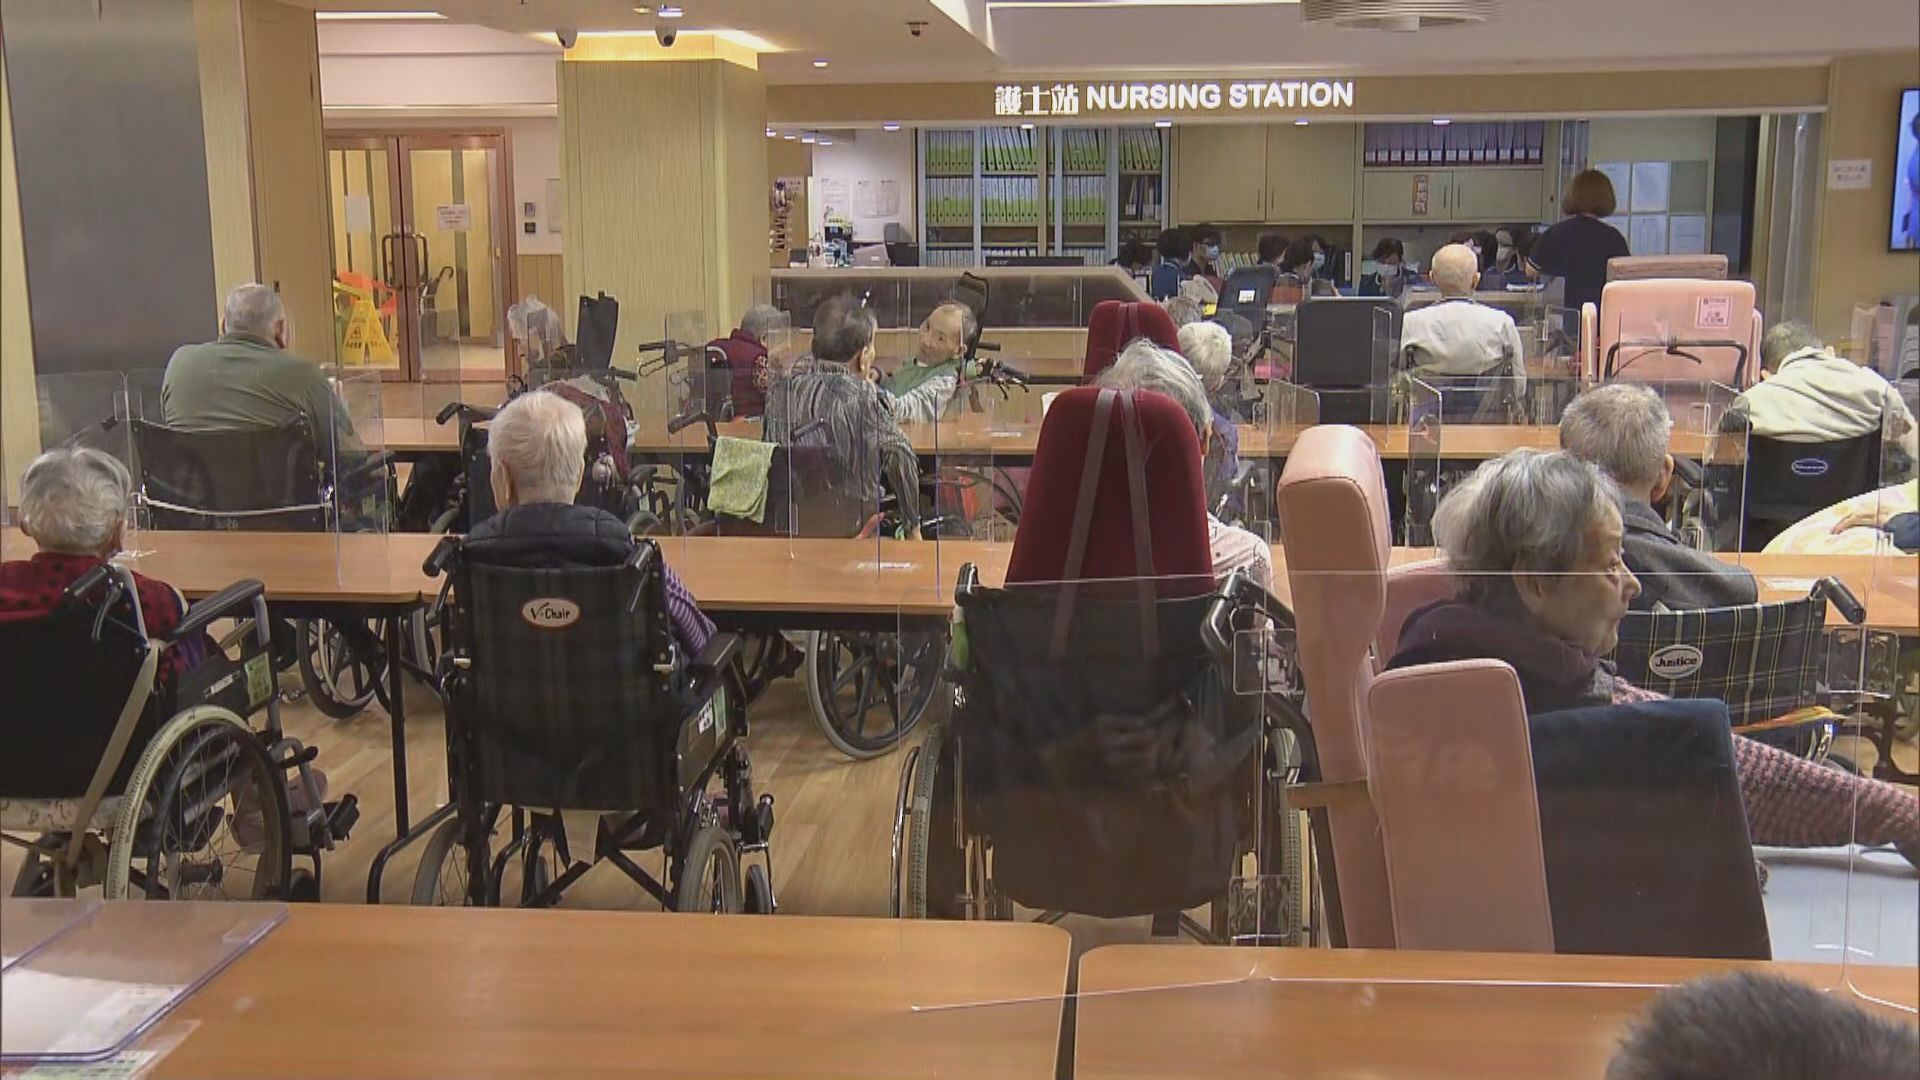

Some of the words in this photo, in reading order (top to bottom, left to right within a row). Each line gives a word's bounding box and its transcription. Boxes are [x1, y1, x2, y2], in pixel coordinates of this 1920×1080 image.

[995, 84, 1079, 115] 護士站
[1086, 83, 1221, 110] NURSING
[1229, 81, 1353, 109] STATION
